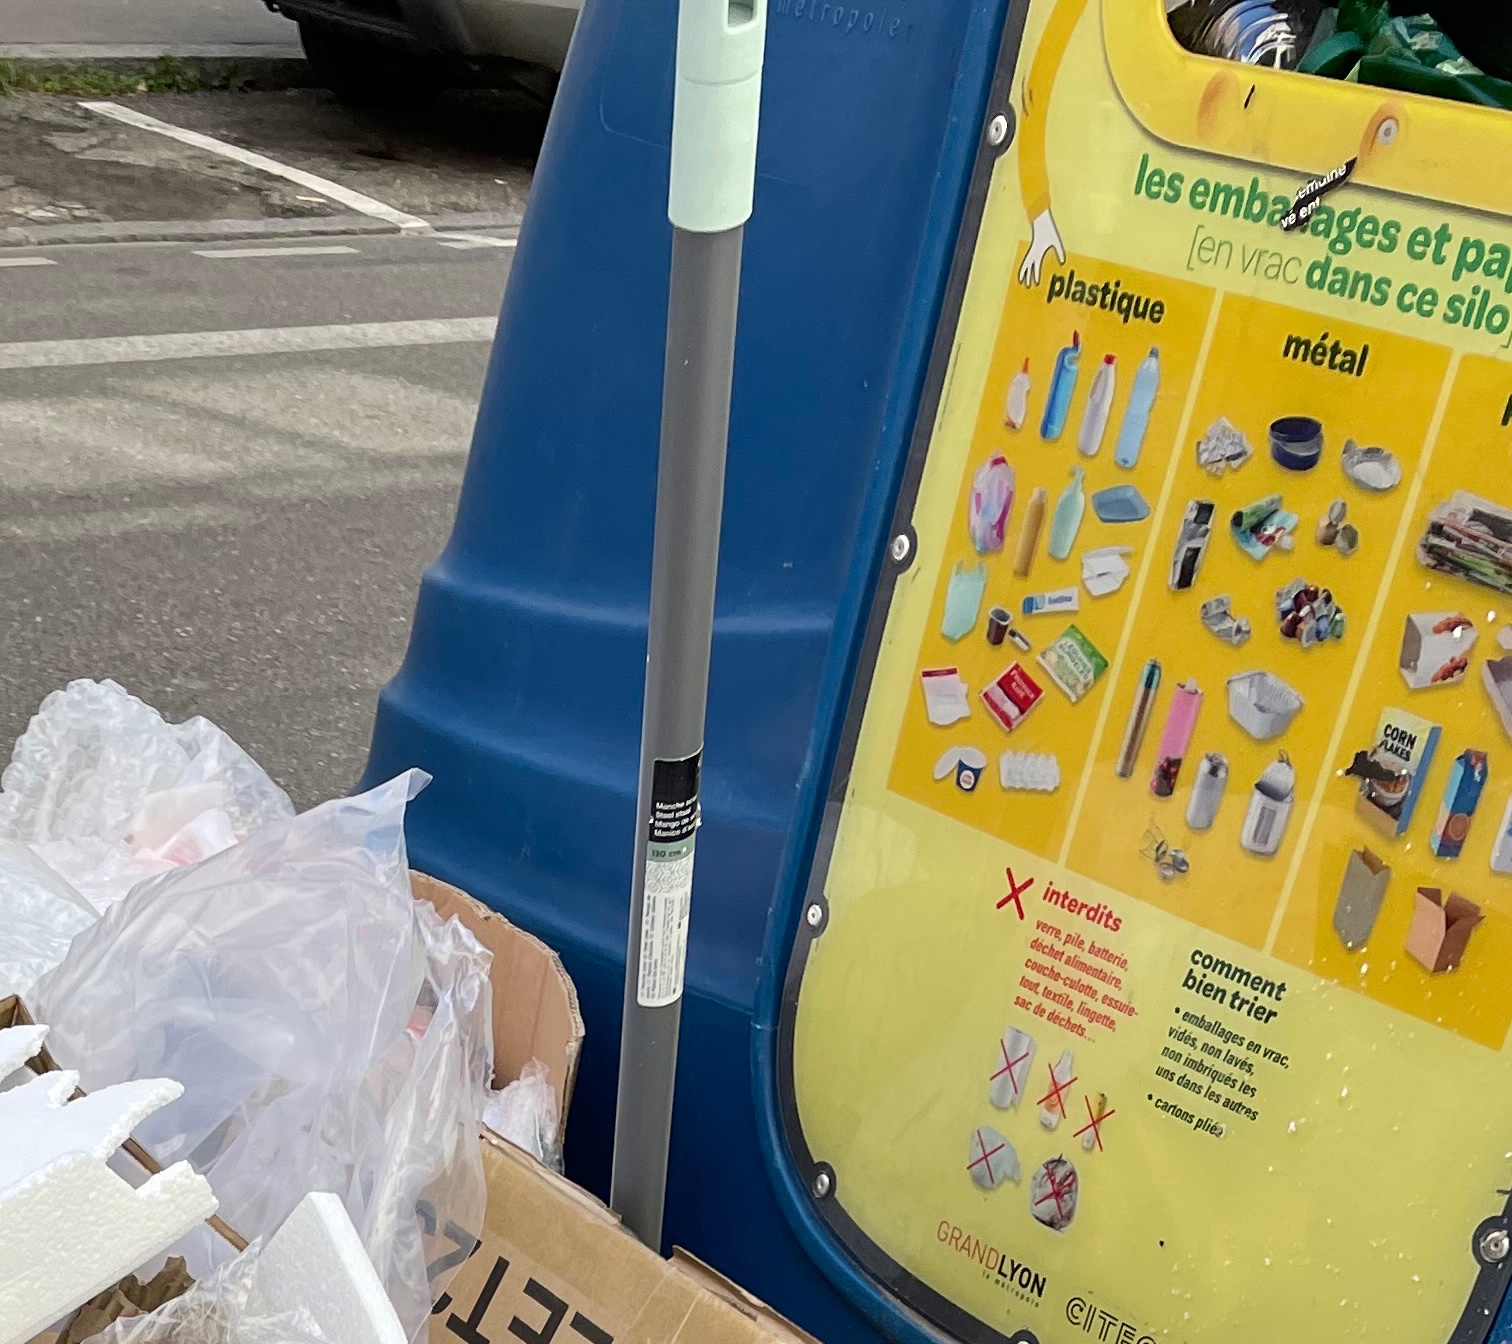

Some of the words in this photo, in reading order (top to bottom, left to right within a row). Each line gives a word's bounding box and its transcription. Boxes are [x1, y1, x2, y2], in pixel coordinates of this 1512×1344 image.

[1133, 152, 1185, 205] les
[1188, 176, 1403, 256] embaages
[1406, 221, 1453, 266] et
[1451, 235, 1512, 294] pa
[1046, 268, 1166, 326] plastique
[1241, 241, 1303, 286] vrac
[1305, 254, 1390, 308] dans
[1396, 281, 1440, 319] ce
[1281, 331, 1370, 378] métal
[1383, 722, 1418, 751] CORN
[1042, 881, 1123, 933] interdits
[1029, 937, 1065, 963] déchet
[1190, 949, 1288, 1002] comment
[1014, 995, 1034, 1012] sac
[1032, 1002, 1047, 1018] de
[1181, 968, 1228, 1005] bien
[1228, 990, 1279, 1026] trier
[1167, 1025, 1199, 1051] vidés,
[1200, 1041, 1223, 1061] non
[1223, 1048, 1256, 1077] lavés,
[1181, 1009, 1246, 1048] emballages
[1246, 1039, 1263, 1056] en
[1262, 1046, 1290, 1070] vrac,
[1154, 1065, 1176, 1083] uns
[1175, 1073, 1204, 1095] dans
[1203, 1085, 1222, 1105] les
[1221, 1098, 1260, 1122] autres
[1160, 1045, 1183, 1064] non
[1182, 1053, 1239, 1090] imbriqués
[1238, 1079, 1258, 1099] les
[1154, 1097, 1196, 1125] cartons
